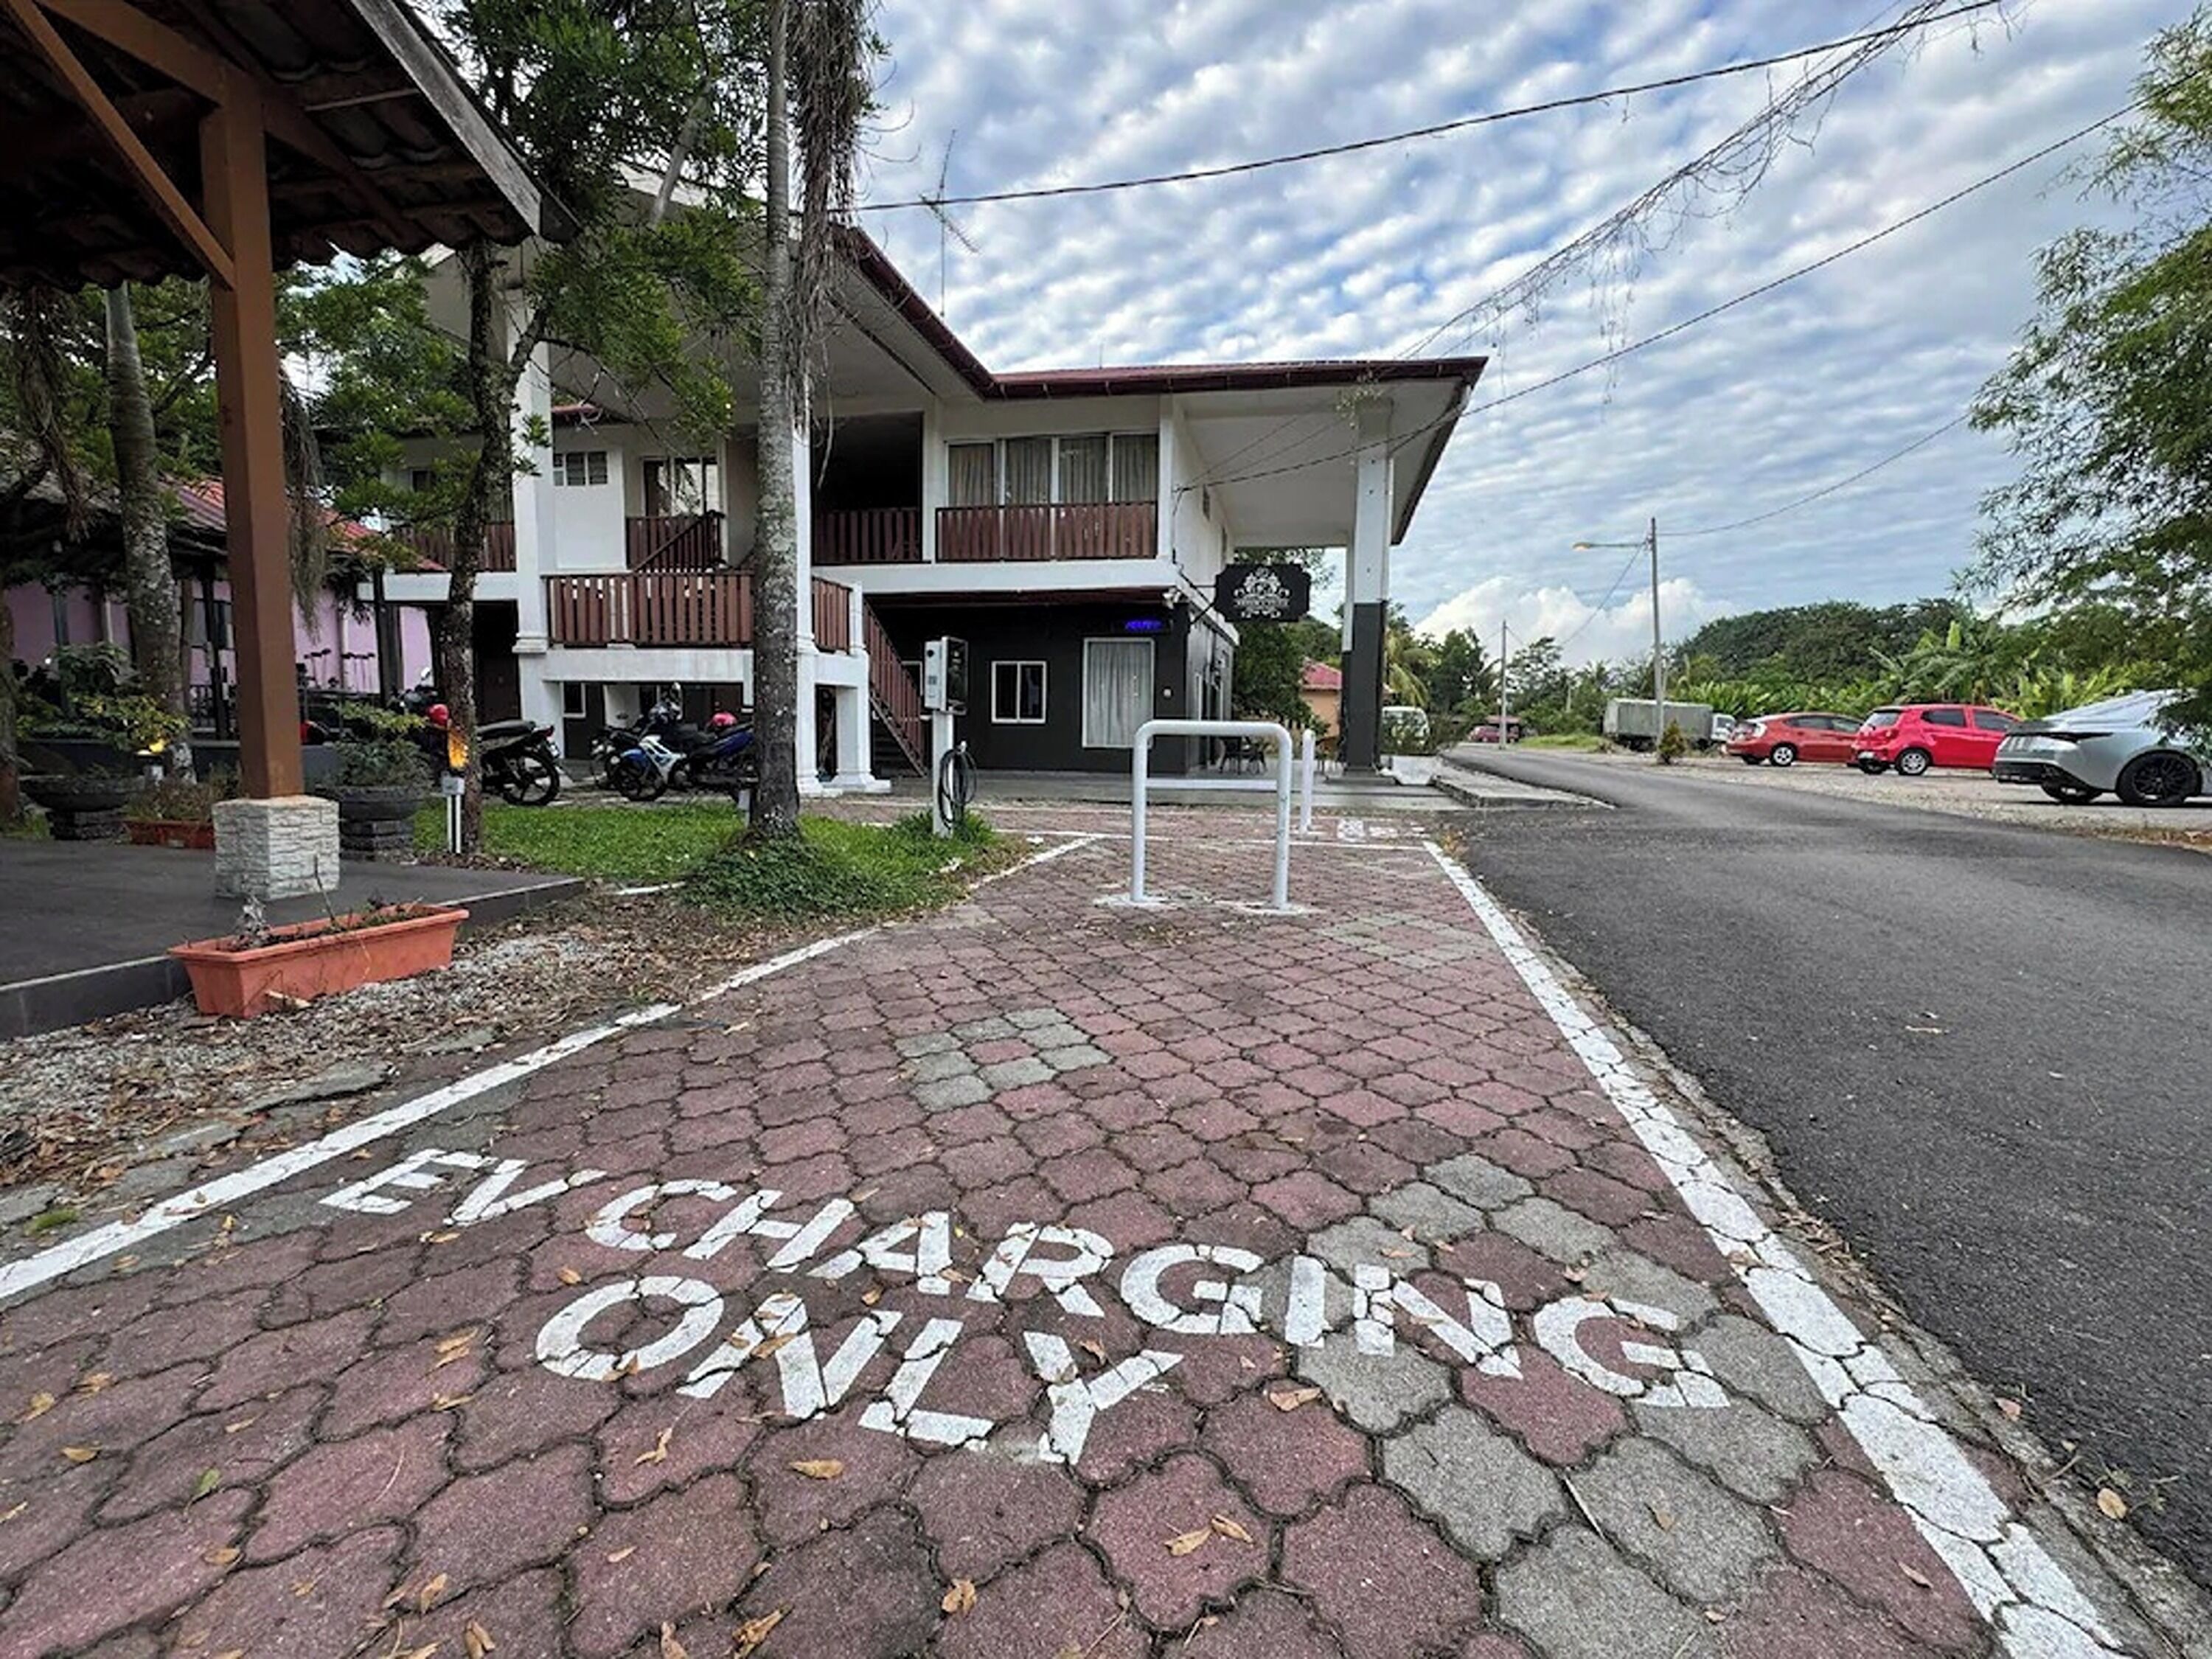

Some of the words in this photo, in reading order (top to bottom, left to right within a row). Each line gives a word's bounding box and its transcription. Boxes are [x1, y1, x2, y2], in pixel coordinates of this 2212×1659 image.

[319, 1148, 606, 1226] EV
[585, 1180, 1731, 1408] CHARGING
[535, 1276, 1183, 1465] ONLY
